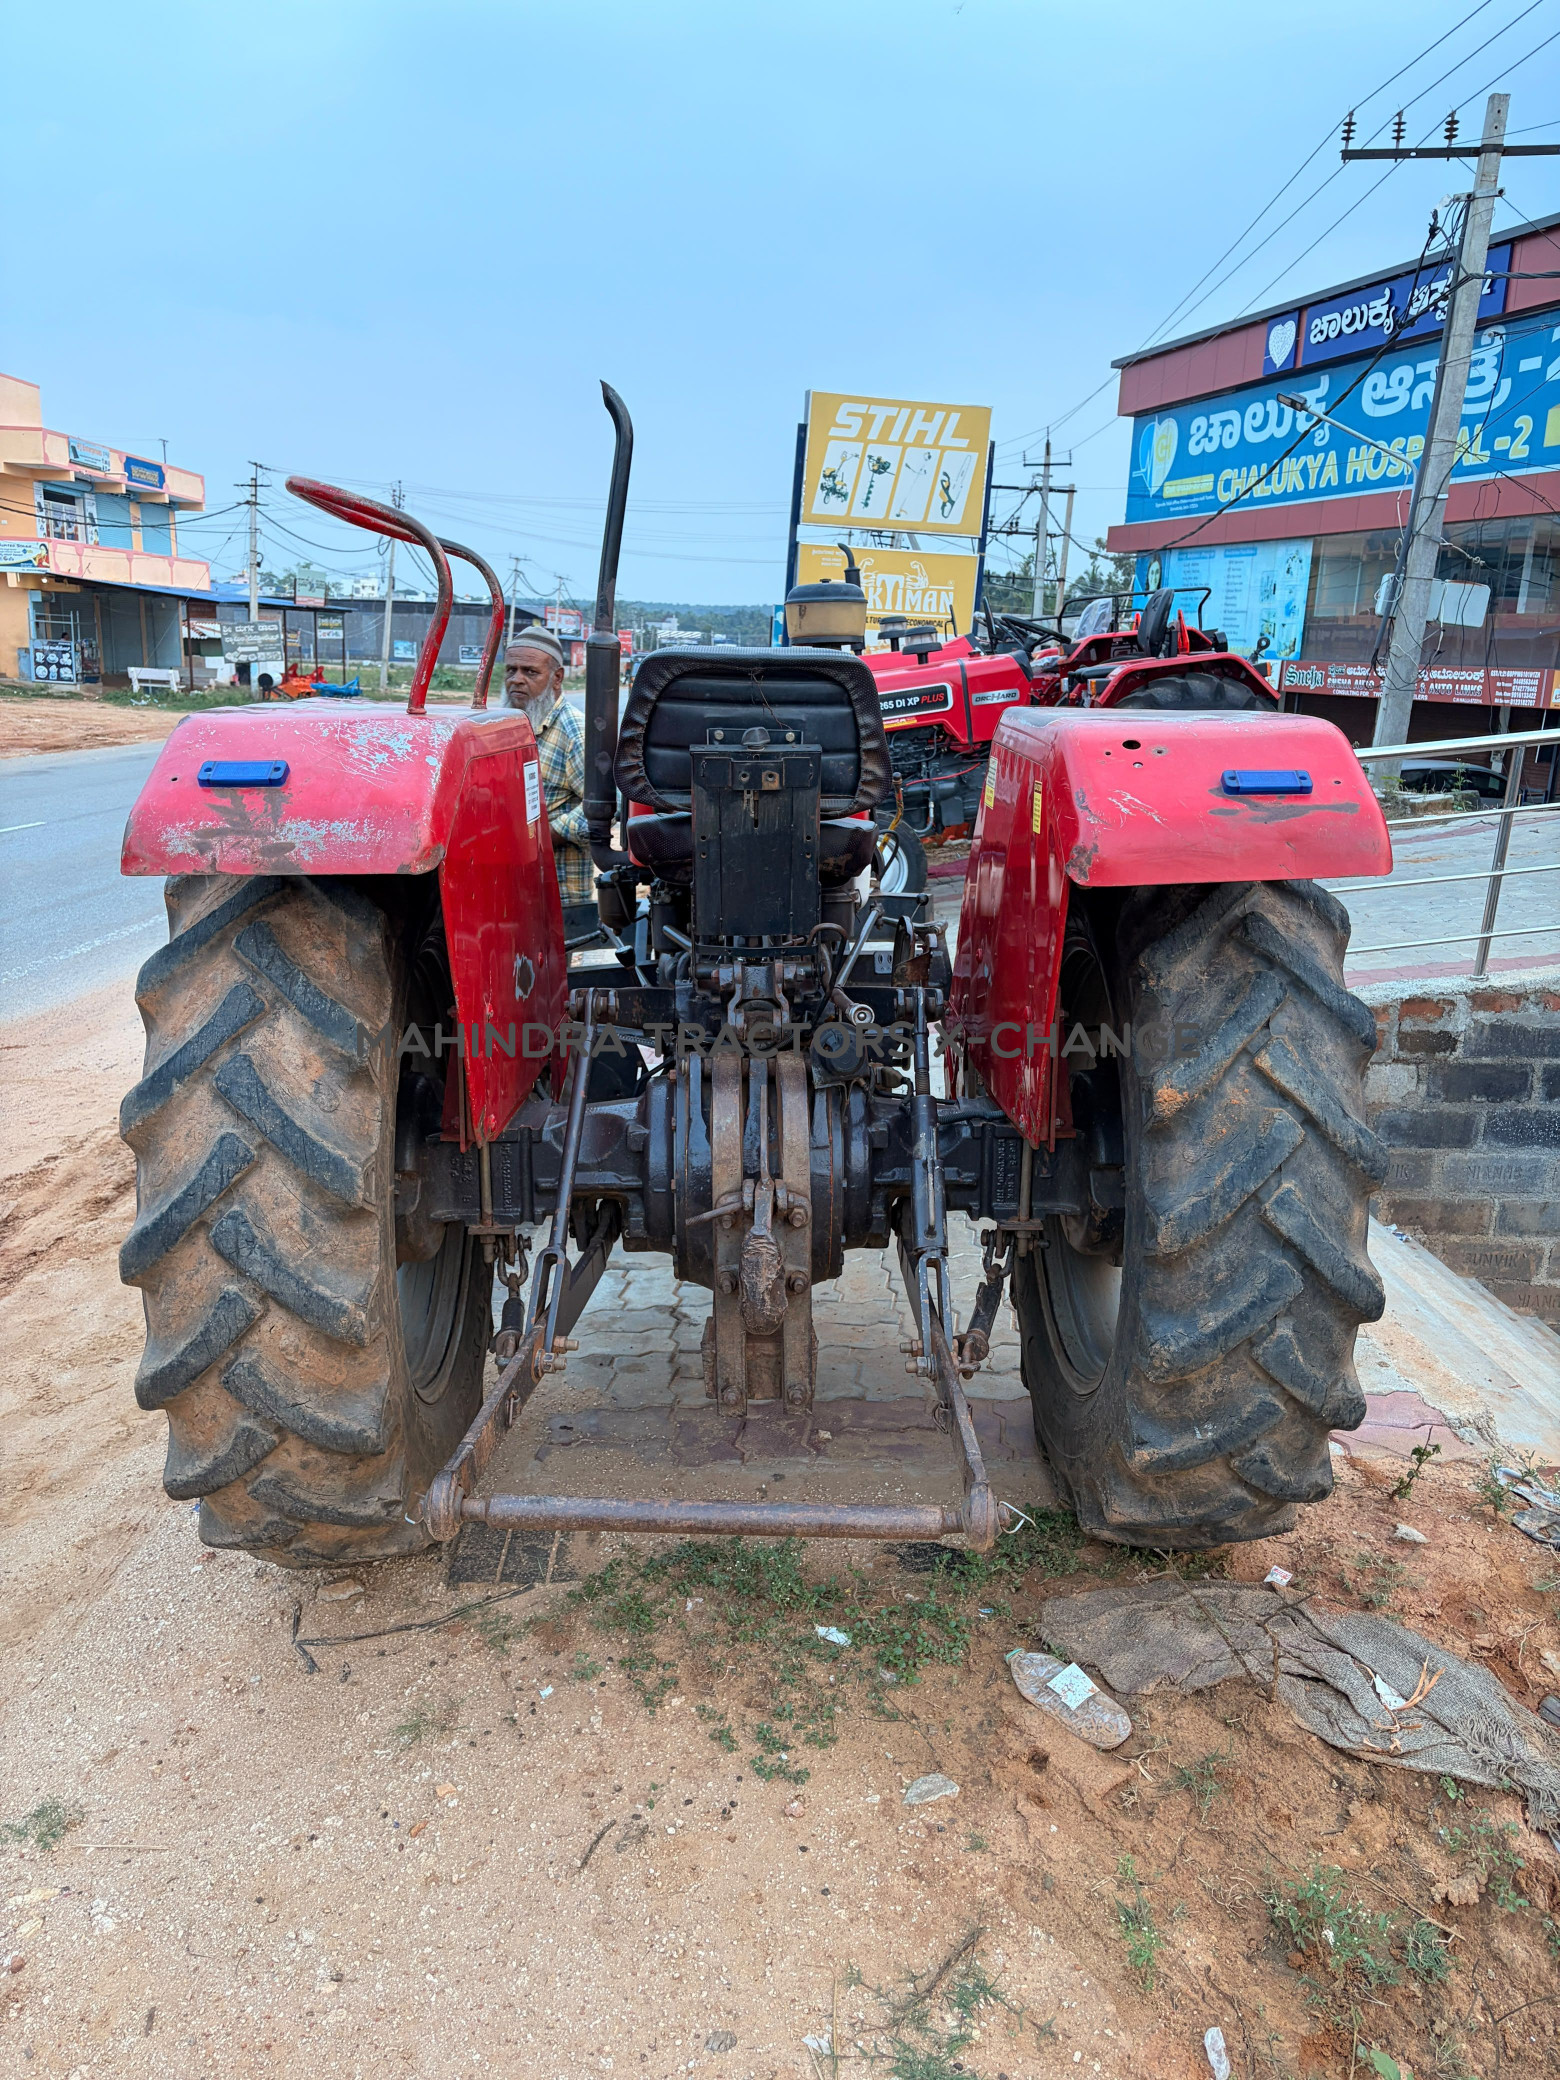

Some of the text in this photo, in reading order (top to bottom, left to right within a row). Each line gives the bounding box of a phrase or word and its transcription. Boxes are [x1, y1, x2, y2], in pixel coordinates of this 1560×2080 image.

[828, 402, 971, 449] STIHL
[1217, 449, 1339, 503] CHALUKYA
[975, 691, 1017, 703] ORCHARD
[1428, 683, 1453, 695] AUTO
[1455, 684, 1483, 697] LINKS
[896, 699, 906, 708] DI
[907, 696, 920, 707] XP
[920, 692, 945, 704] PLUS
